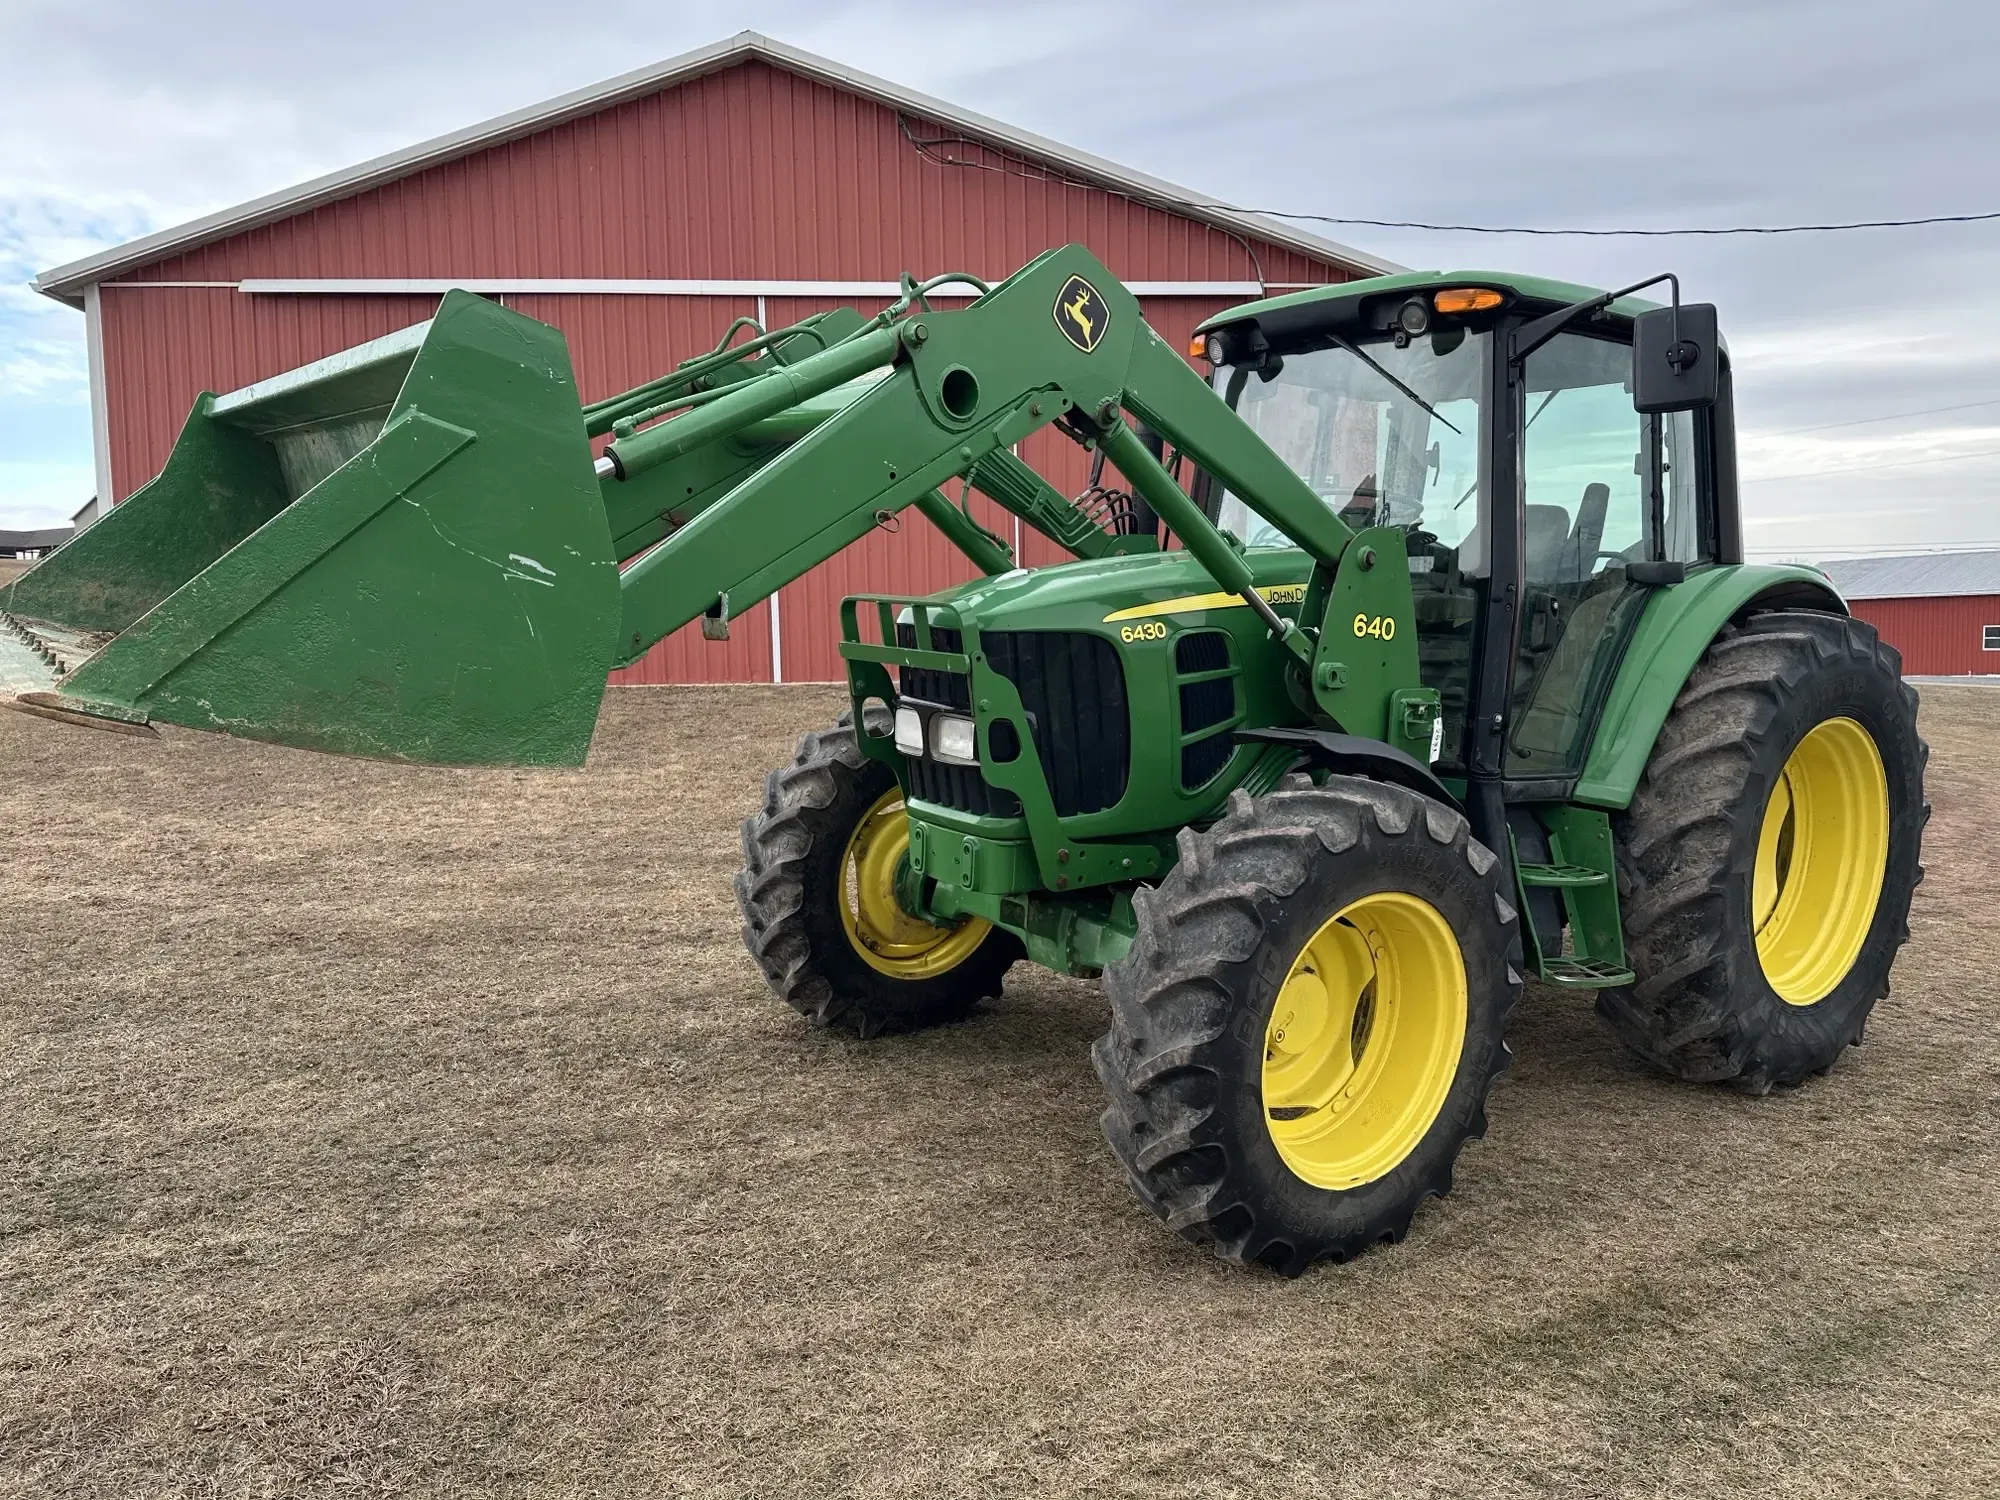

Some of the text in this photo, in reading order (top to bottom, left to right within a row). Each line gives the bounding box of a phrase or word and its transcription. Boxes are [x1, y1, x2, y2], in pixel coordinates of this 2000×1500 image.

[1267, 589, 1295, 603] JOHN
[1120, 621, 1167, 644] 6430
[1353, 612, 1396, 642] 640
[1232, 947, 1283, 1051] BKT
